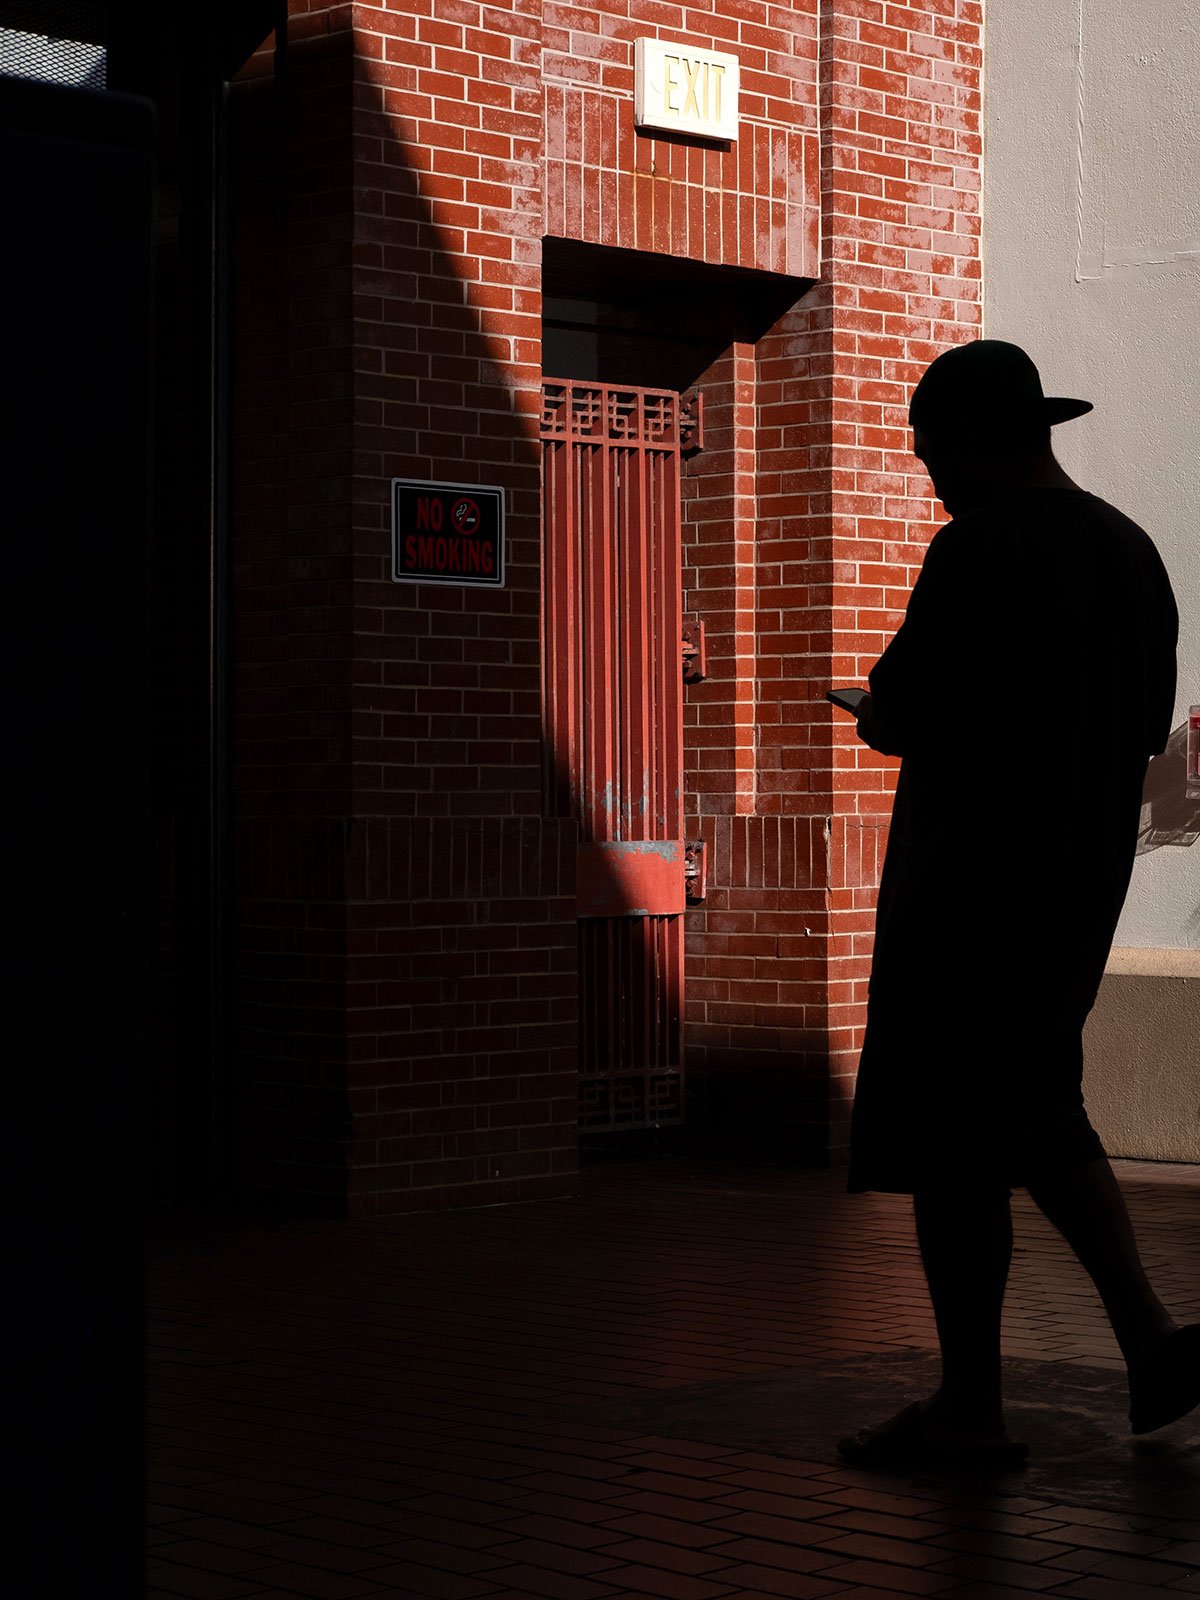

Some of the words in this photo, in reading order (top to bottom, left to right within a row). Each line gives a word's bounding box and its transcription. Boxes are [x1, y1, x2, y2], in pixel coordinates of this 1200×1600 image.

[664, 54, 725, 123] EXIT
[417, 496, 443, 532] NO
[405, 535, 493, 573] SMOKING
